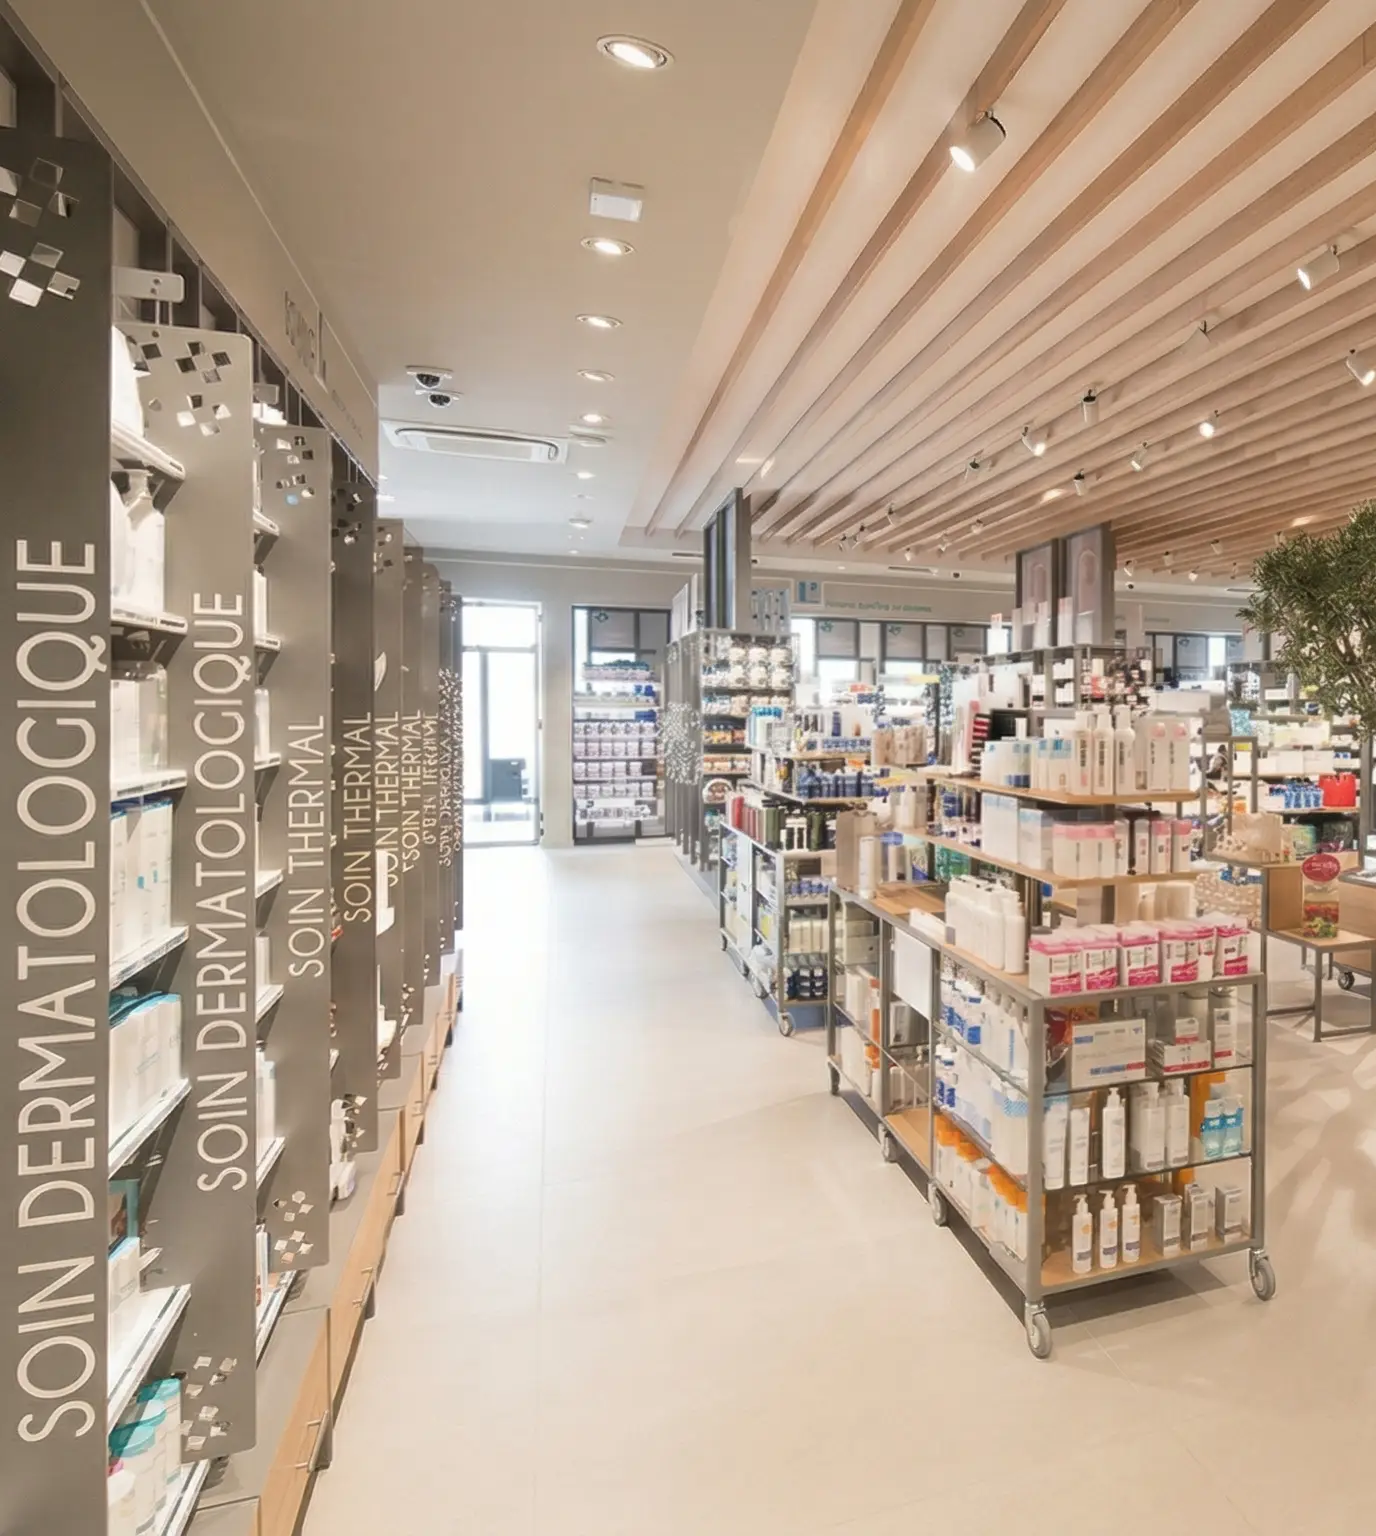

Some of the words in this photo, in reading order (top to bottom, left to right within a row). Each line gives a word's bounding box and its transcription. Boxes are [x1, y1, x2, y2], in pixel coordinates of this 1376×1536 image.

[288, 715, 325, 874] THERMAL
[343, 711, 372, 840] THERMAL
[375, 711, 399, 823] THERMAL
[401, 709, 421, 807] THERMAL
[16, 539, 107, 1229] DERMATOLOGIQUE
[193, 592, 251, 1052] DERMATOLOGIQUE
[288, 889, 325, 978] SOIN
[343, 850, 372, 924] SOIN
[196, 1071, 249, 1191] SOIN
[17, 1255, 96, 1442] SOIN
